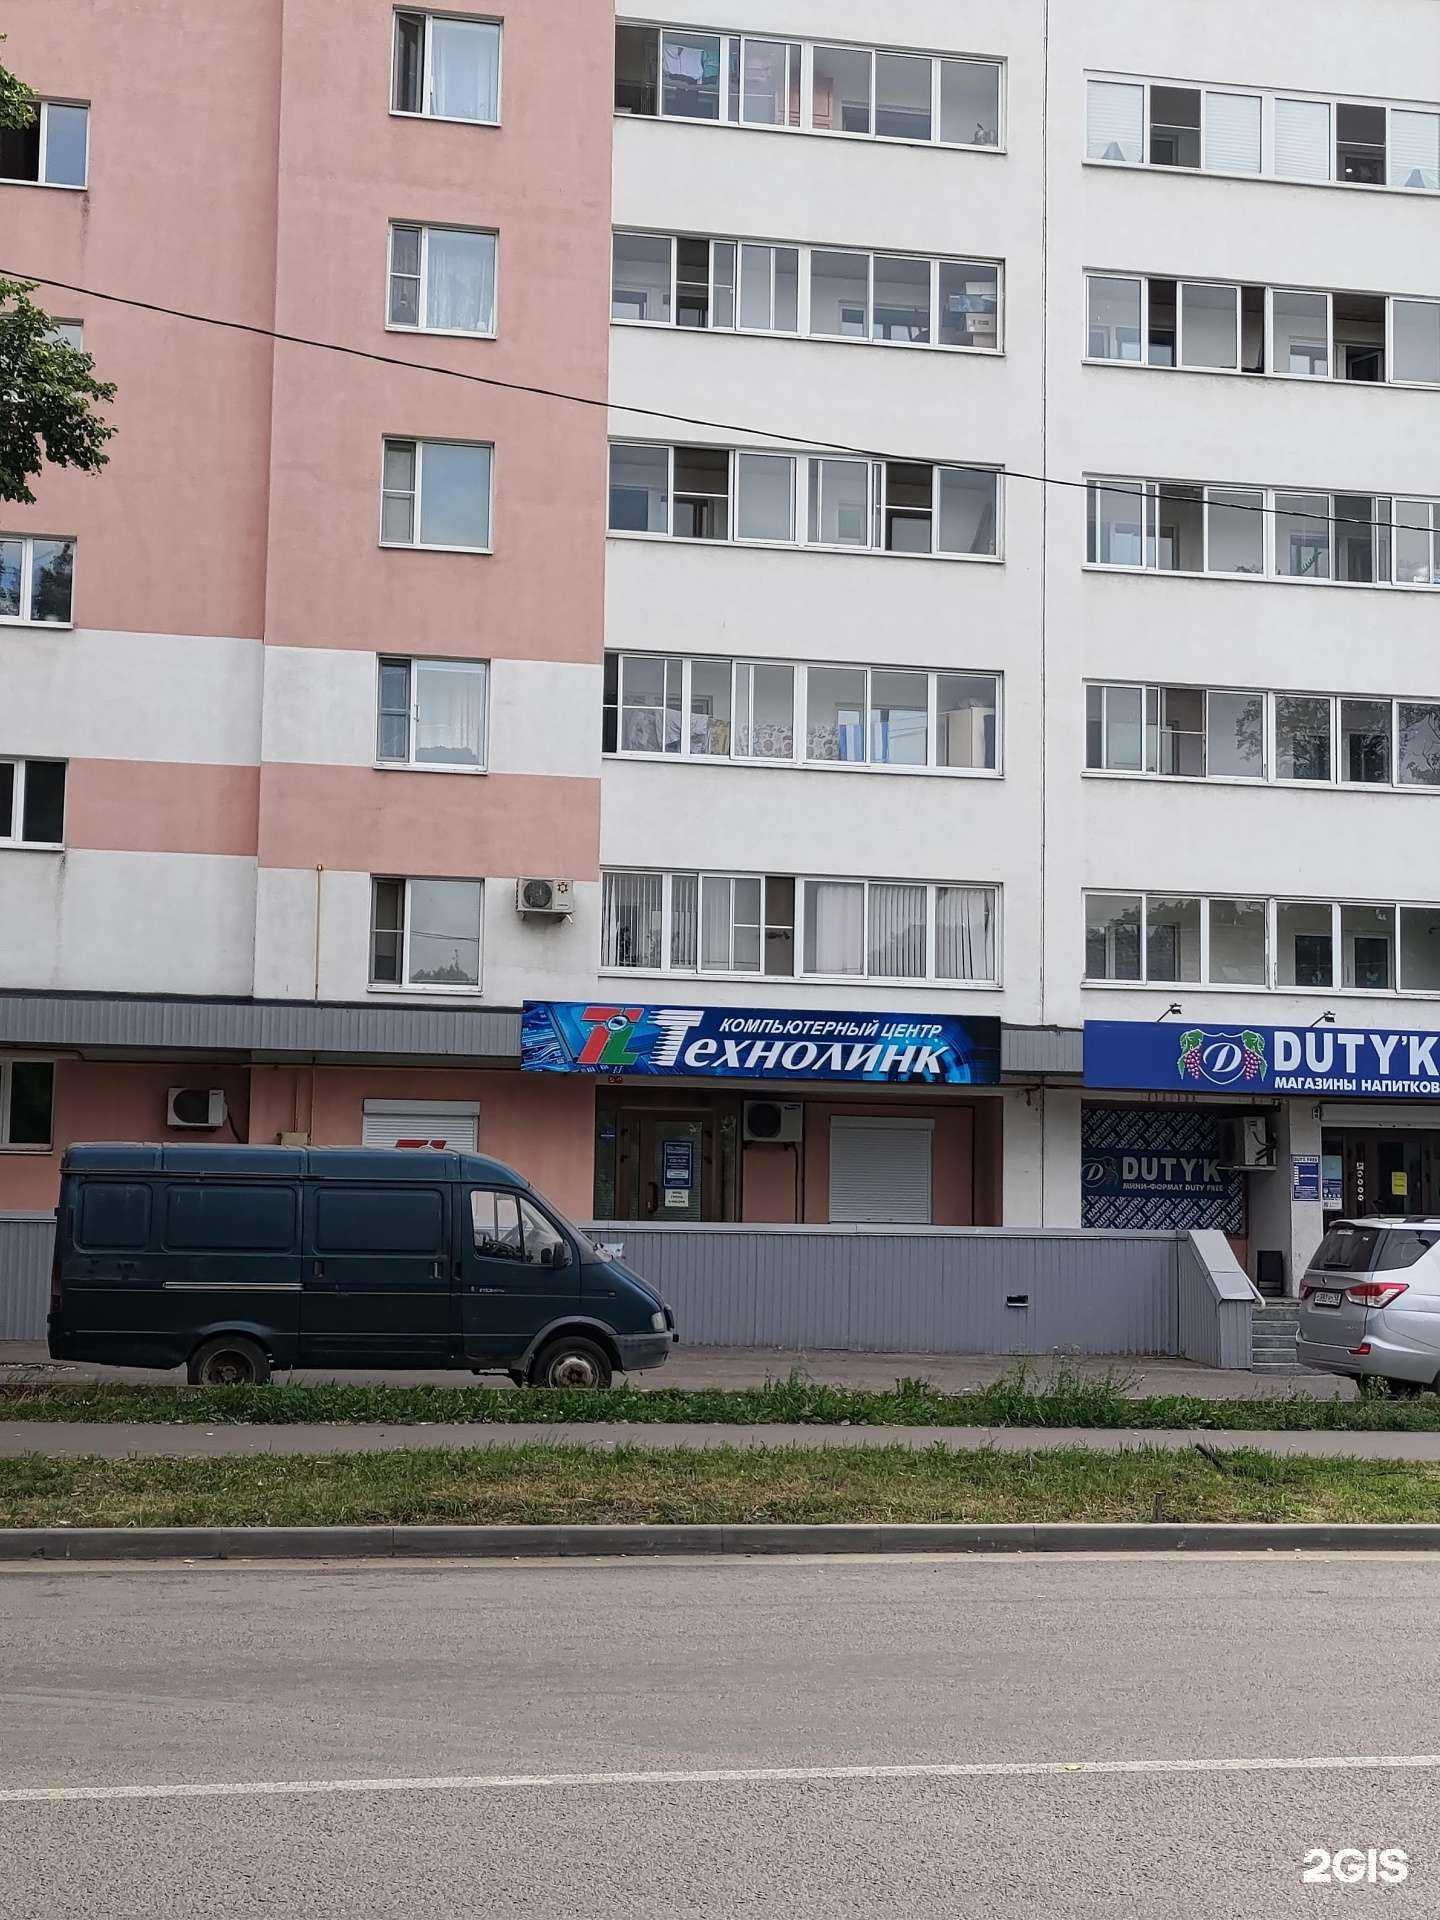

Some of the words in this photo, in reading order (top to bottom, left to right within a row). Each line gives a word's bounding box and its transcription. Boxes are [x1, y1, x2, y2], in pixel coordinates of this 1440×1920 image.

[719, 1018, 880, 1036] КОМПЬЮТЕРНЫЙ
[881, 1023, 943, 1039] ЦЕНТР
[1274, 1076, 1356, 1090] МАГАЗИНЫ
[1361, 1080, 1440, 1094] НАПИТКОВ
[1185, 1183, 1205, 1191] DUTY
